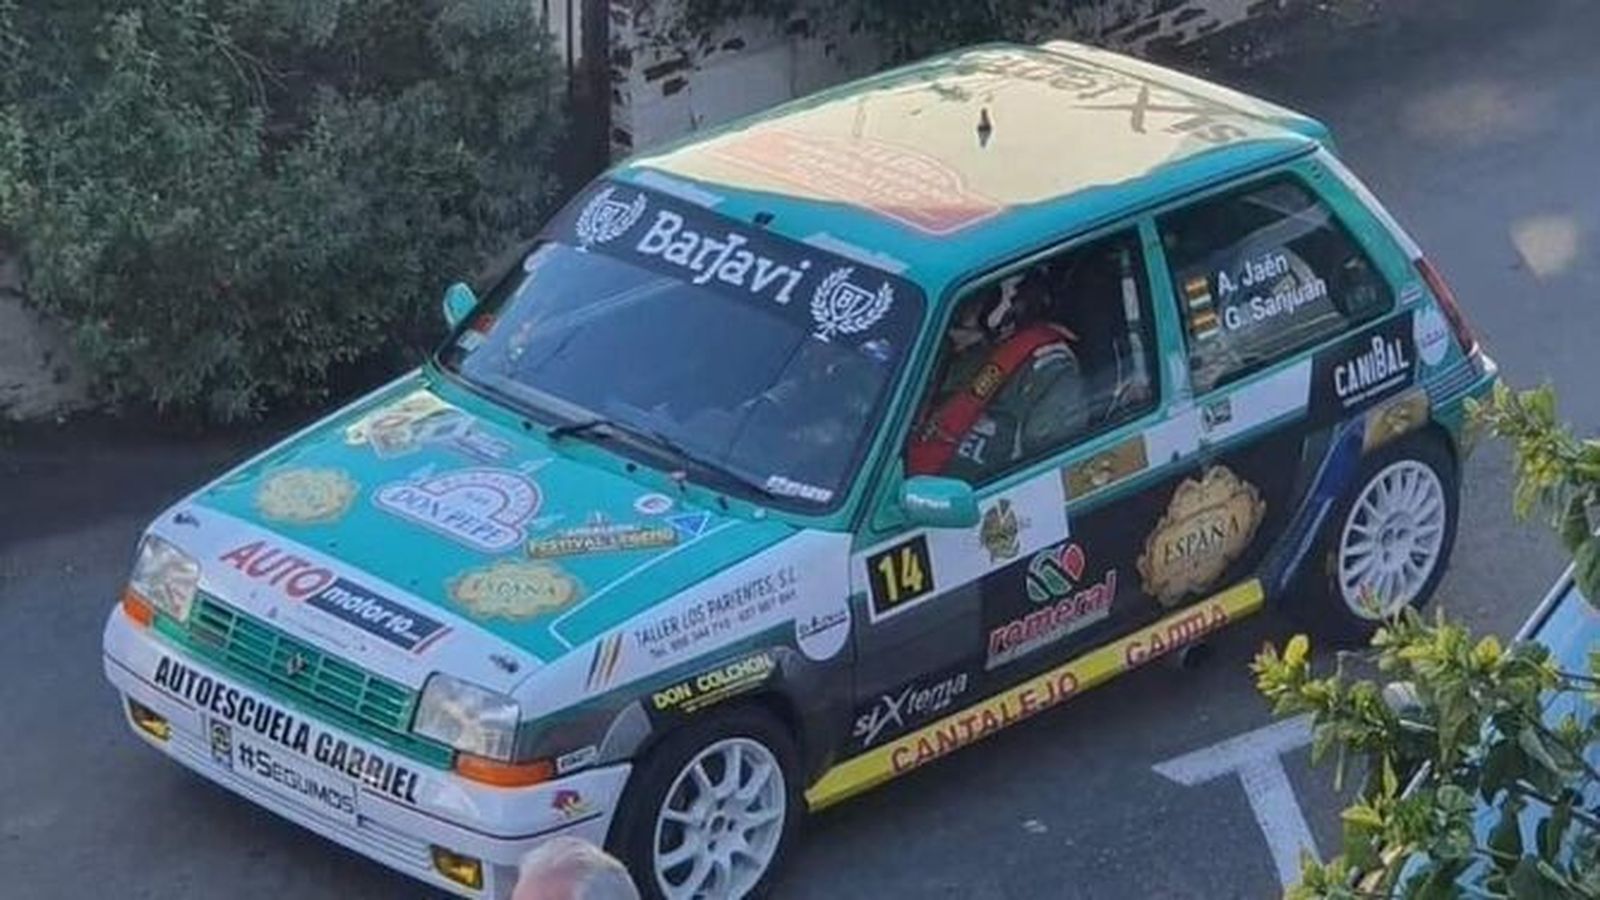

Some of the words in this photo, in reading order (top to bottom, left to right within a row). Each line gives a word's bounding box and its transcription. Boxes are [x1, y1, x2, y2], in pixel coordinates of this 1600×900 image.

[636, 209, 811, 305] BarJavi
[1217, 271, 1238, 296] A.
[1242, 252, 1289, 287] Jaén
[1225, 306, 1248, 331] G.
[219, 540, 335, 599] AUTO
[877, 547, 924, 602] 14
[634, 615, 680, 648] TALLER
[988, 569, 1117, 655] romeral
[652, 682, 693, 710] DON
[697, 652, 776, 692] COLCHON
[154, 656, 311, 756] AUTOESCUELA
[314, 731, 420, 804] GABRIEL
[890, 671, 1079, 774] CANTALEJO
